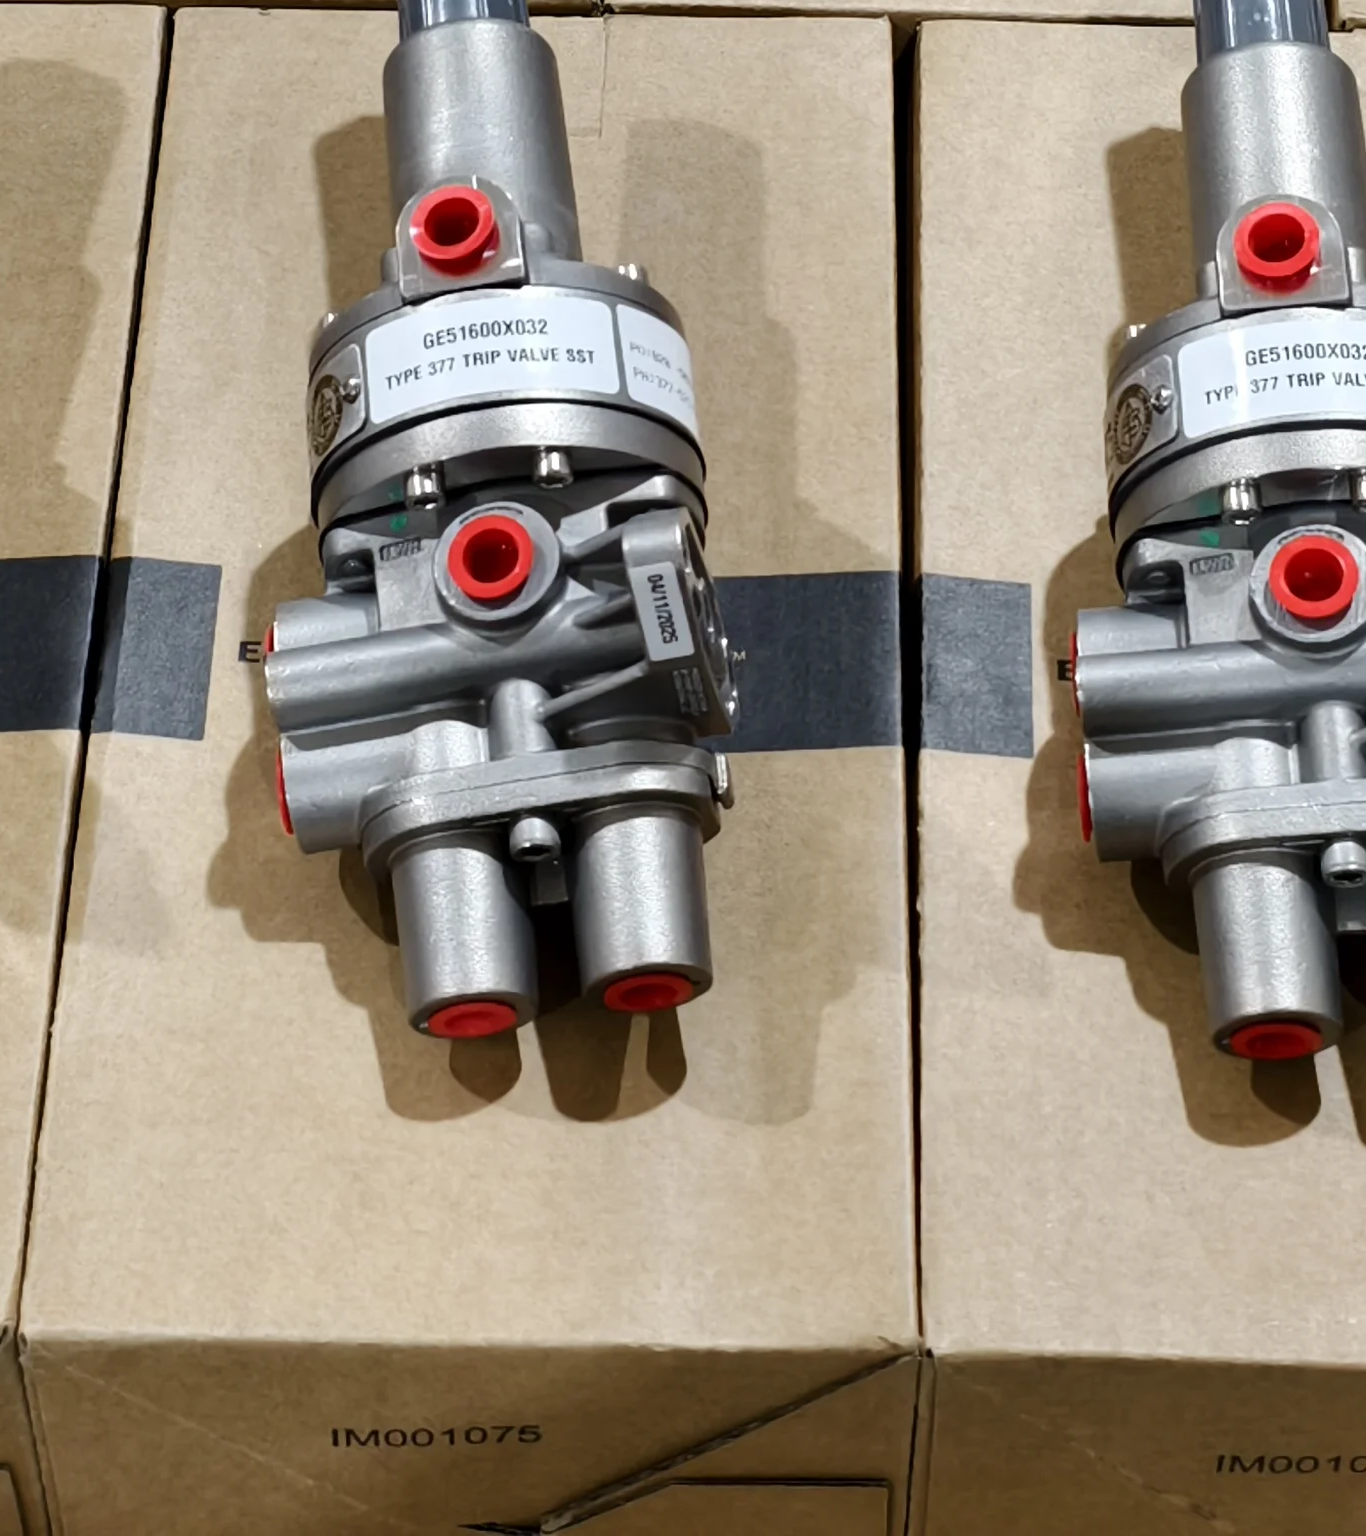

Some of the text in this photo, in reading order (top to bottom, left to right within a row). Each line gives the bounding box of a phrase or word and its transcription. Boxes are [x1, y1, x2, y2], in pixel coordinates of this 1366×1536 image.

[423, 318, 549, 350] GE51600X032
[384, 347, 596, 391] TYPE 377 TRIP VALVE SST
[1249, 376, 1279, 395] 377
[1286, 372, 1326, 389] TRIP
[646, 572, 679, 645] 04/11/2025
[331, 1424, 543, 1448] IM001075
